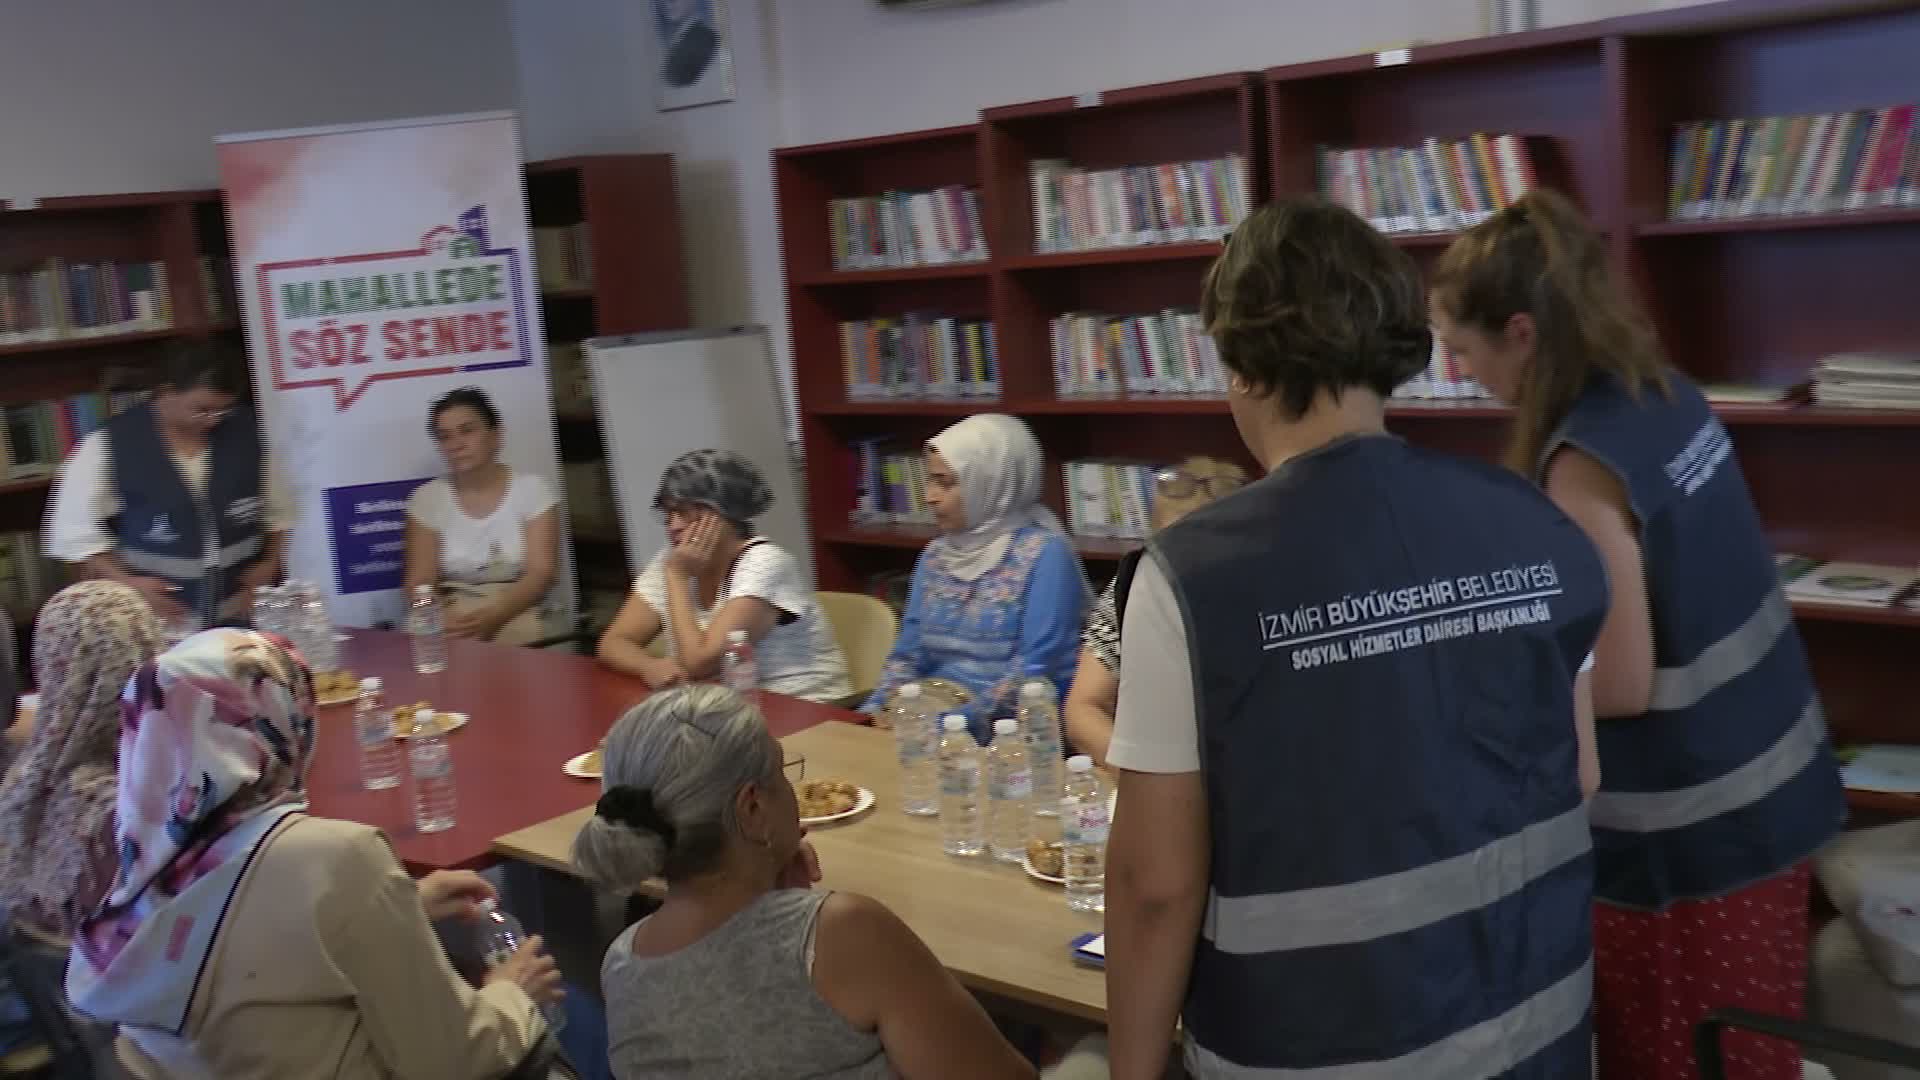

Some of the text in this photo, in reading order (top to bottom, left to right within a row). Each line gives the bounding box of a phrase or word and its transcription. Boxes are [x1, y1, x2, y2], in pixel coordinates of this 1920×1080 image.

[281, 264, 506, 319] MAHALLEDE
[289, 311, 512, 369] SÖZ SENDE
[1258, 560, 1558, 640] İZMİR BÜYÜKŞEHİR BELEDİYESİ
[1291, 600, 1551, 671] SOSYAL HİZMETLER DAİRESİ BAŞKANLIĞI
